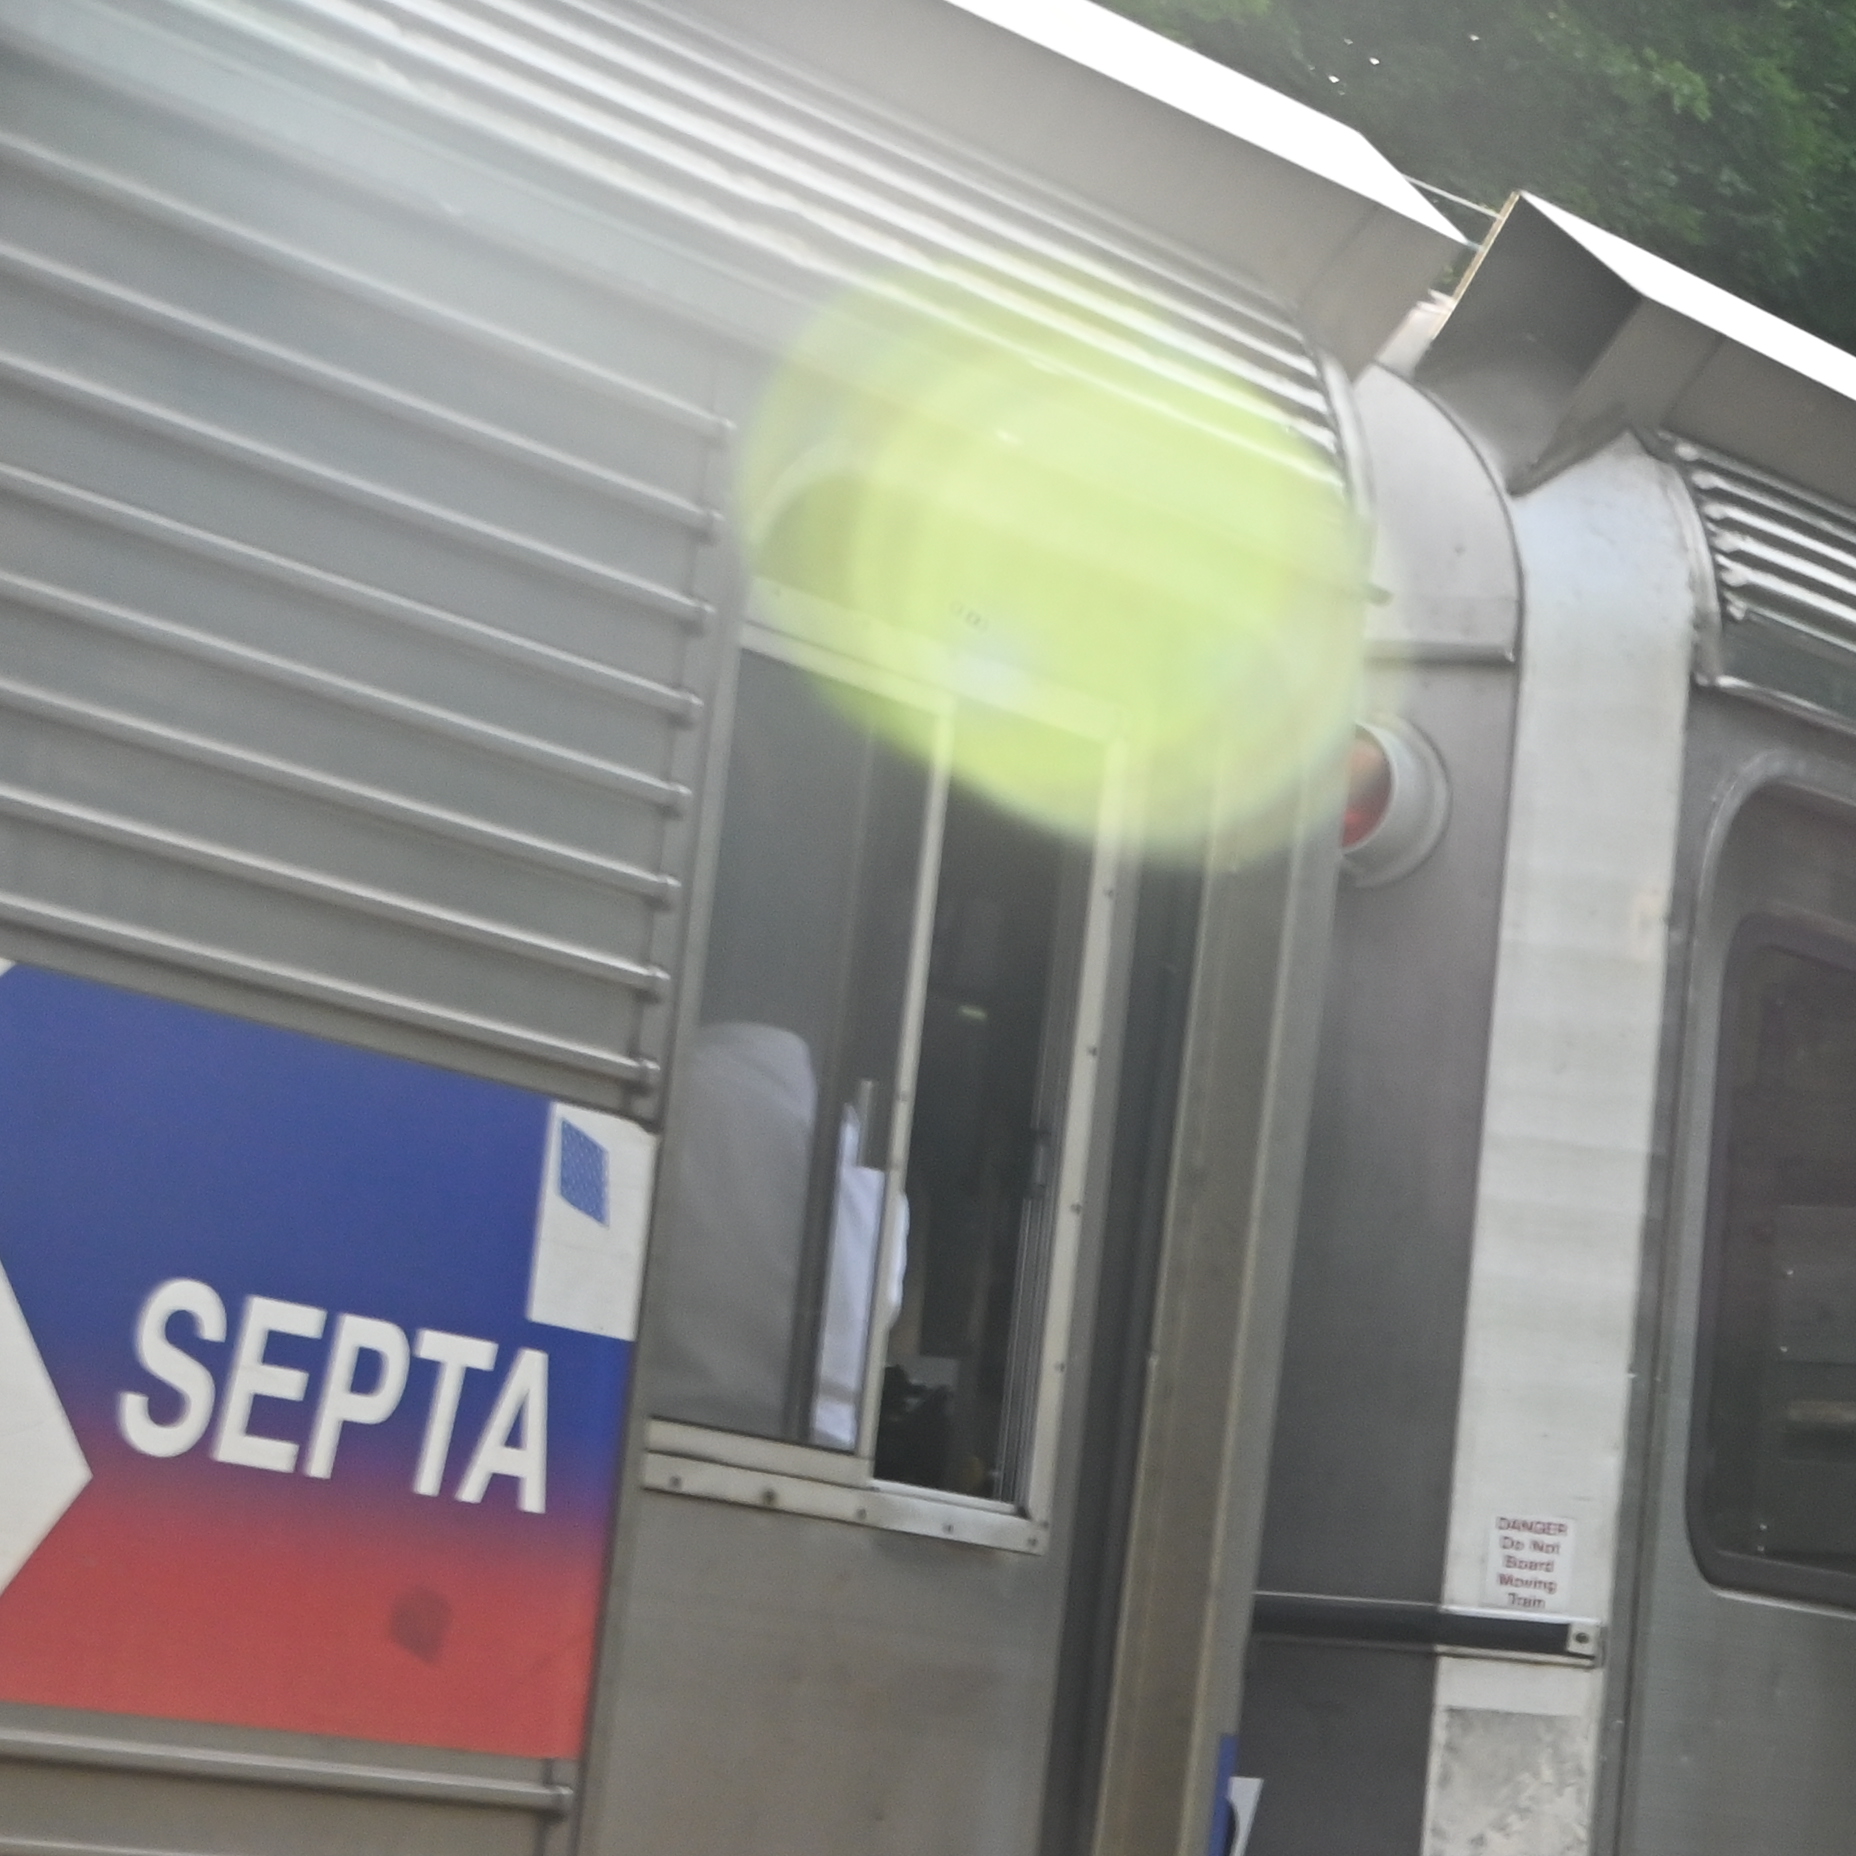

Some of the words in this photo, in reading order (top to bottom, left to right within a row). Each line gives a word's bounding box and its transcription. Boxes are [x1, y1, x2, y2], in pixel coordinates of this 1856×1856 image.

[118, 1278, 550, 1514] SEPTA
[1497, 1517, 1568, 1536] DANGER
[1501, 1536, 1525, 1551] Do
[1530, 1540, 1560, 1555] Not
[1504, 1555, 1555, 1573] Board
[1498, 1573, 1557, 1595] Moving
[1508, 1592, 1546, 1609] Train
